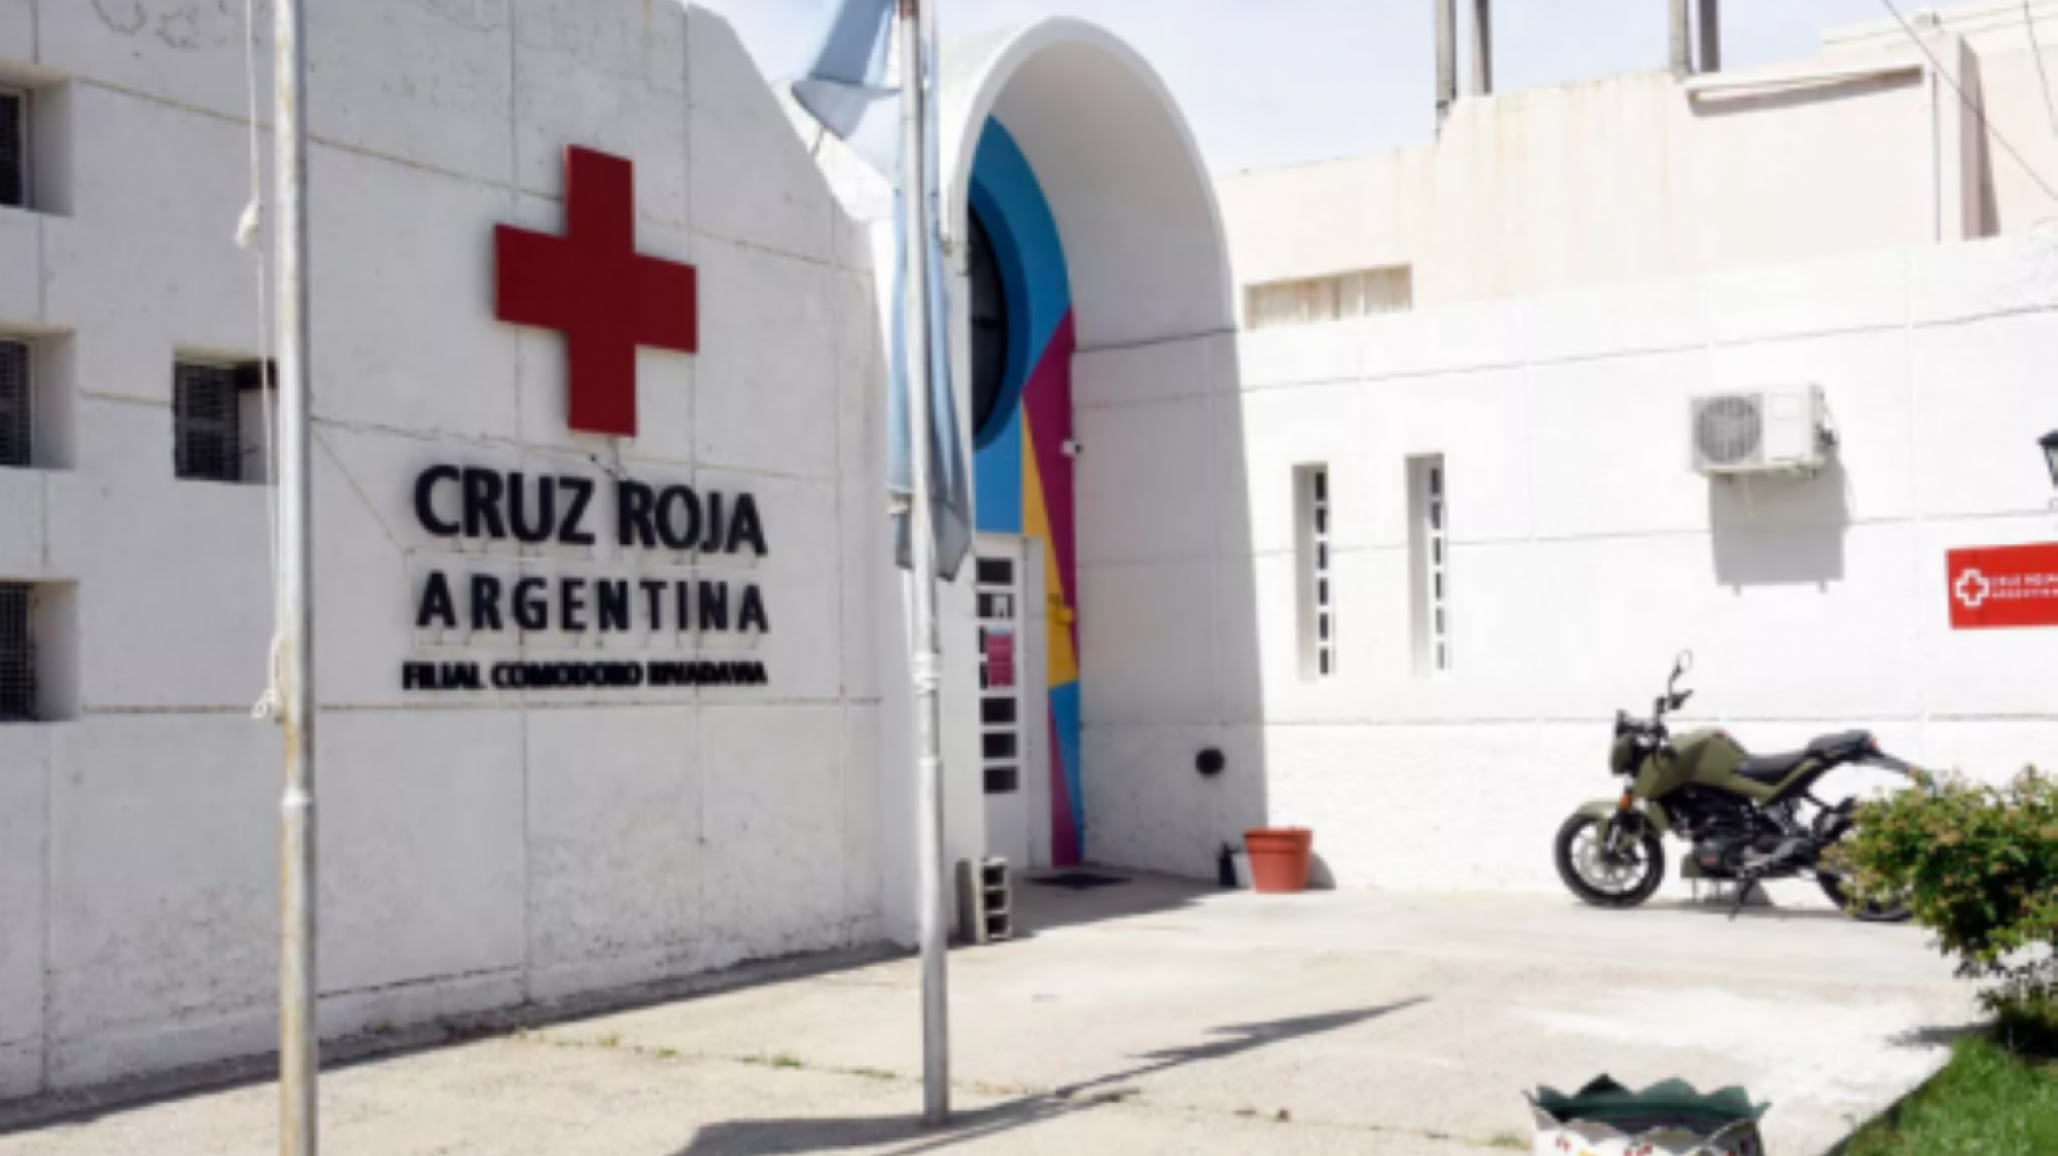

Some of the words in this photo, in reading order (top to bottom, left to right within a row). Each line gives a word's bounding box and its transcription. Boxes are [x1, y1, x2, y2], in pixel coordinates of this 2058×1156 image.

[413, 464, 595, 546] CRUZ
[615, 479, 768, 556] ROJA
[415, 571, 769, 633] ARGENTINA
[402, 661, 486, 690] FILIAL
